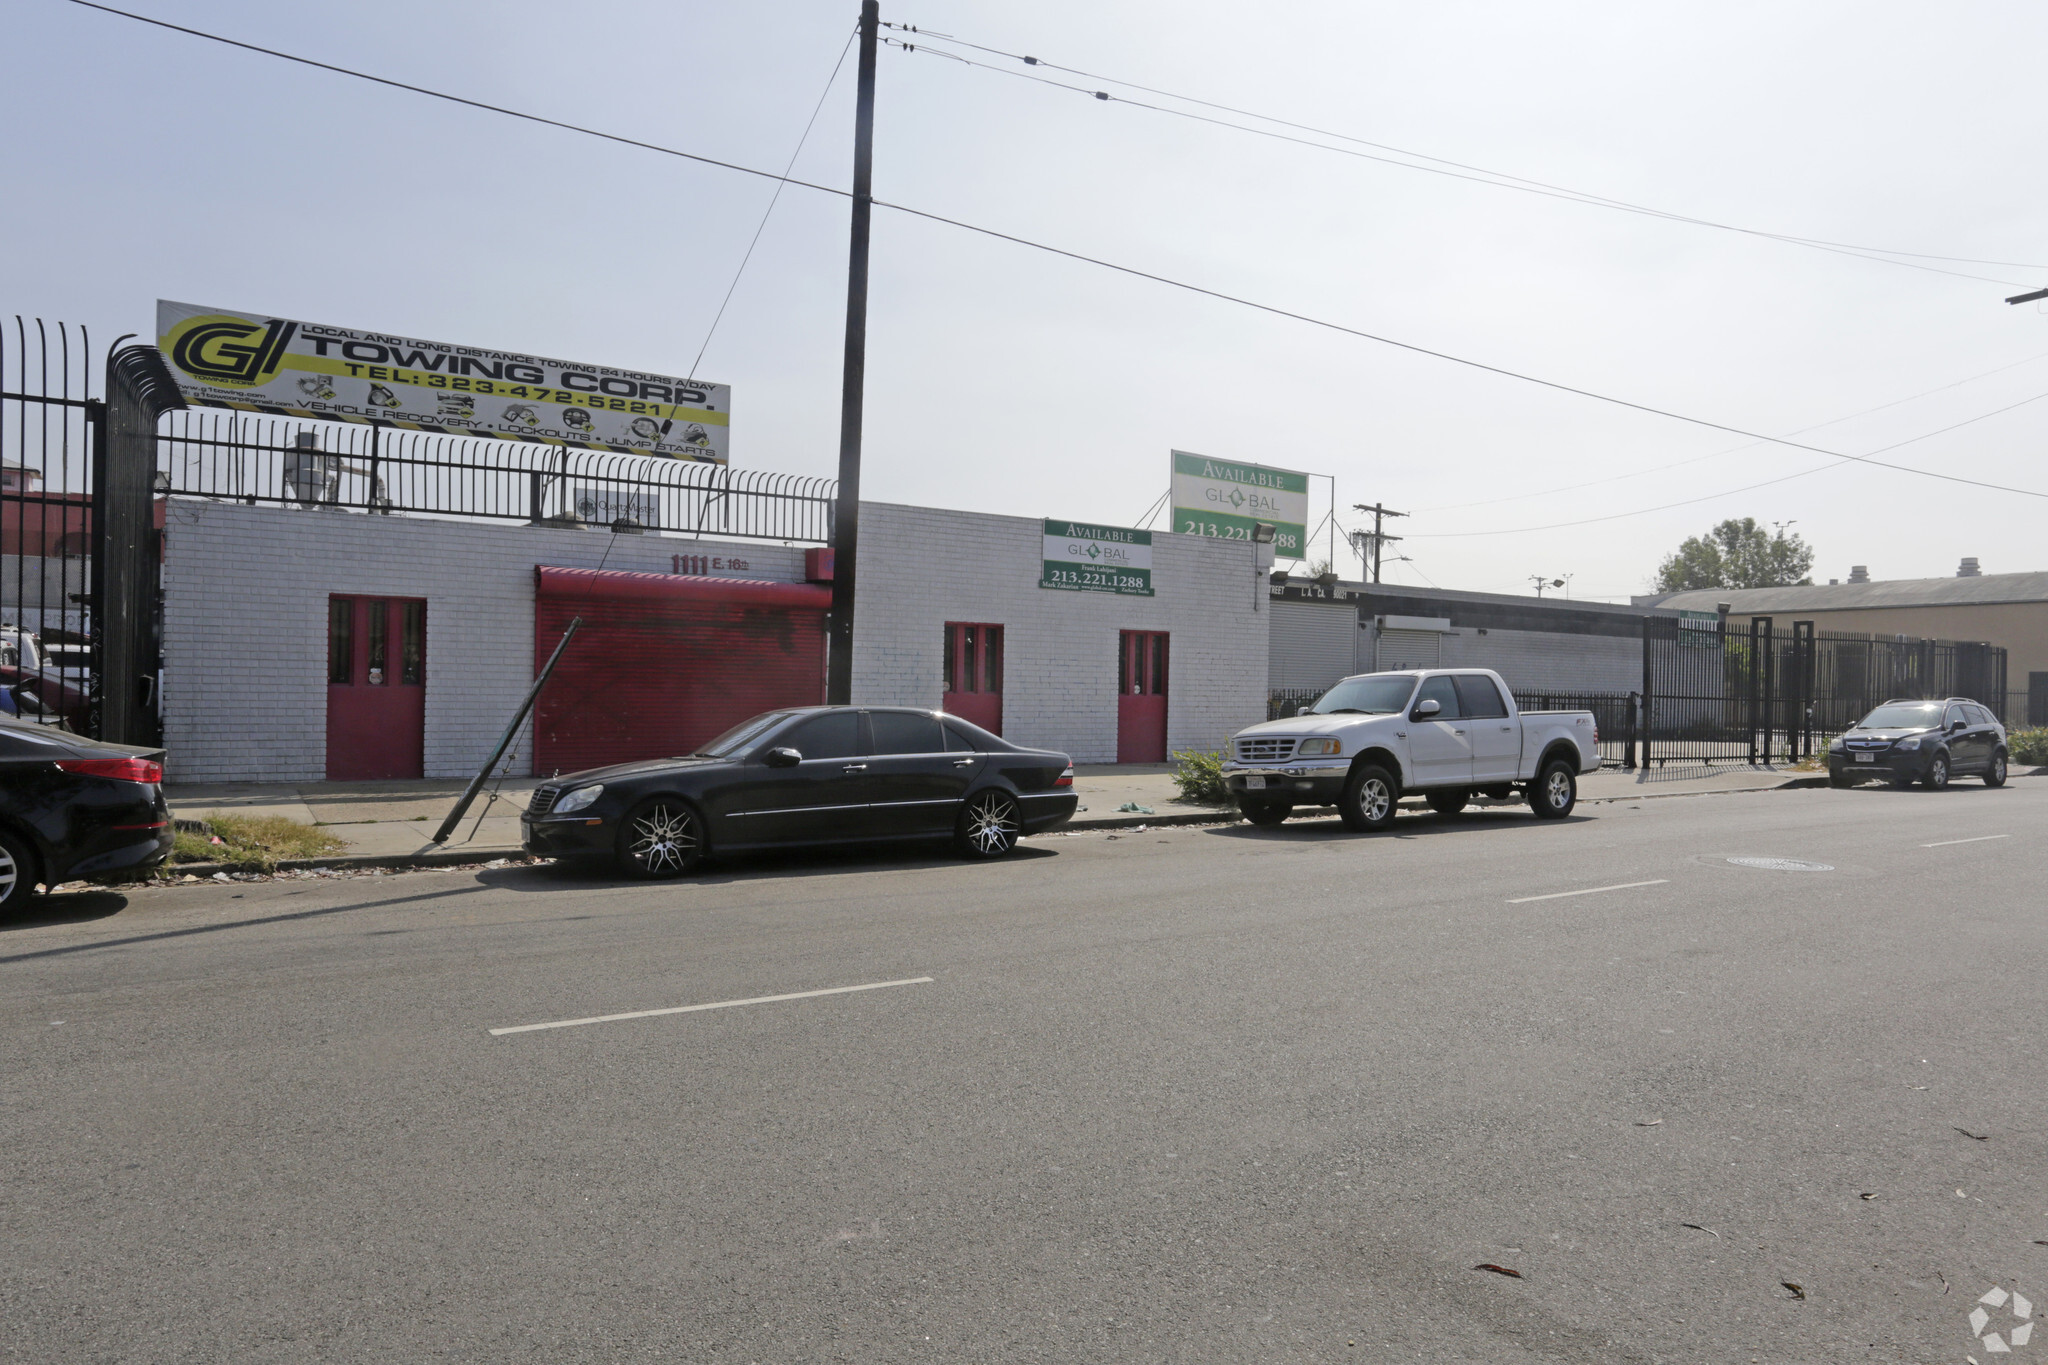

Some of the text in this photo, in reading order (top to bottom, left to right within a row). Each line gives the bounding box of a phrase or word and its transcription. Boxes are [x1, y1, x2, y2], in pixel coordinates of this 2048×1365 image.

[302, 324, 717, 392] LOCAL AND LONG DISTANCE TOWING 24 HOURS A DAY
[193, 375, 228, 383] TOWING
[301, 333, 715, 412] TOWING CORP.
[193, 391, 294, 407] g1towcorp@gmail.com
[295, 399, 716, 457] VEHICLE RECOVERY LOCKOUTS JUMP STARTS
[1202, 460, 1285, 489] AVAILABLE
[1066, 523, 1134, 543] AVAILABLE
[671, 554, 750, 575] 1111 E. 16th
[1051, 570, 1144, 588] 213.221.1288
